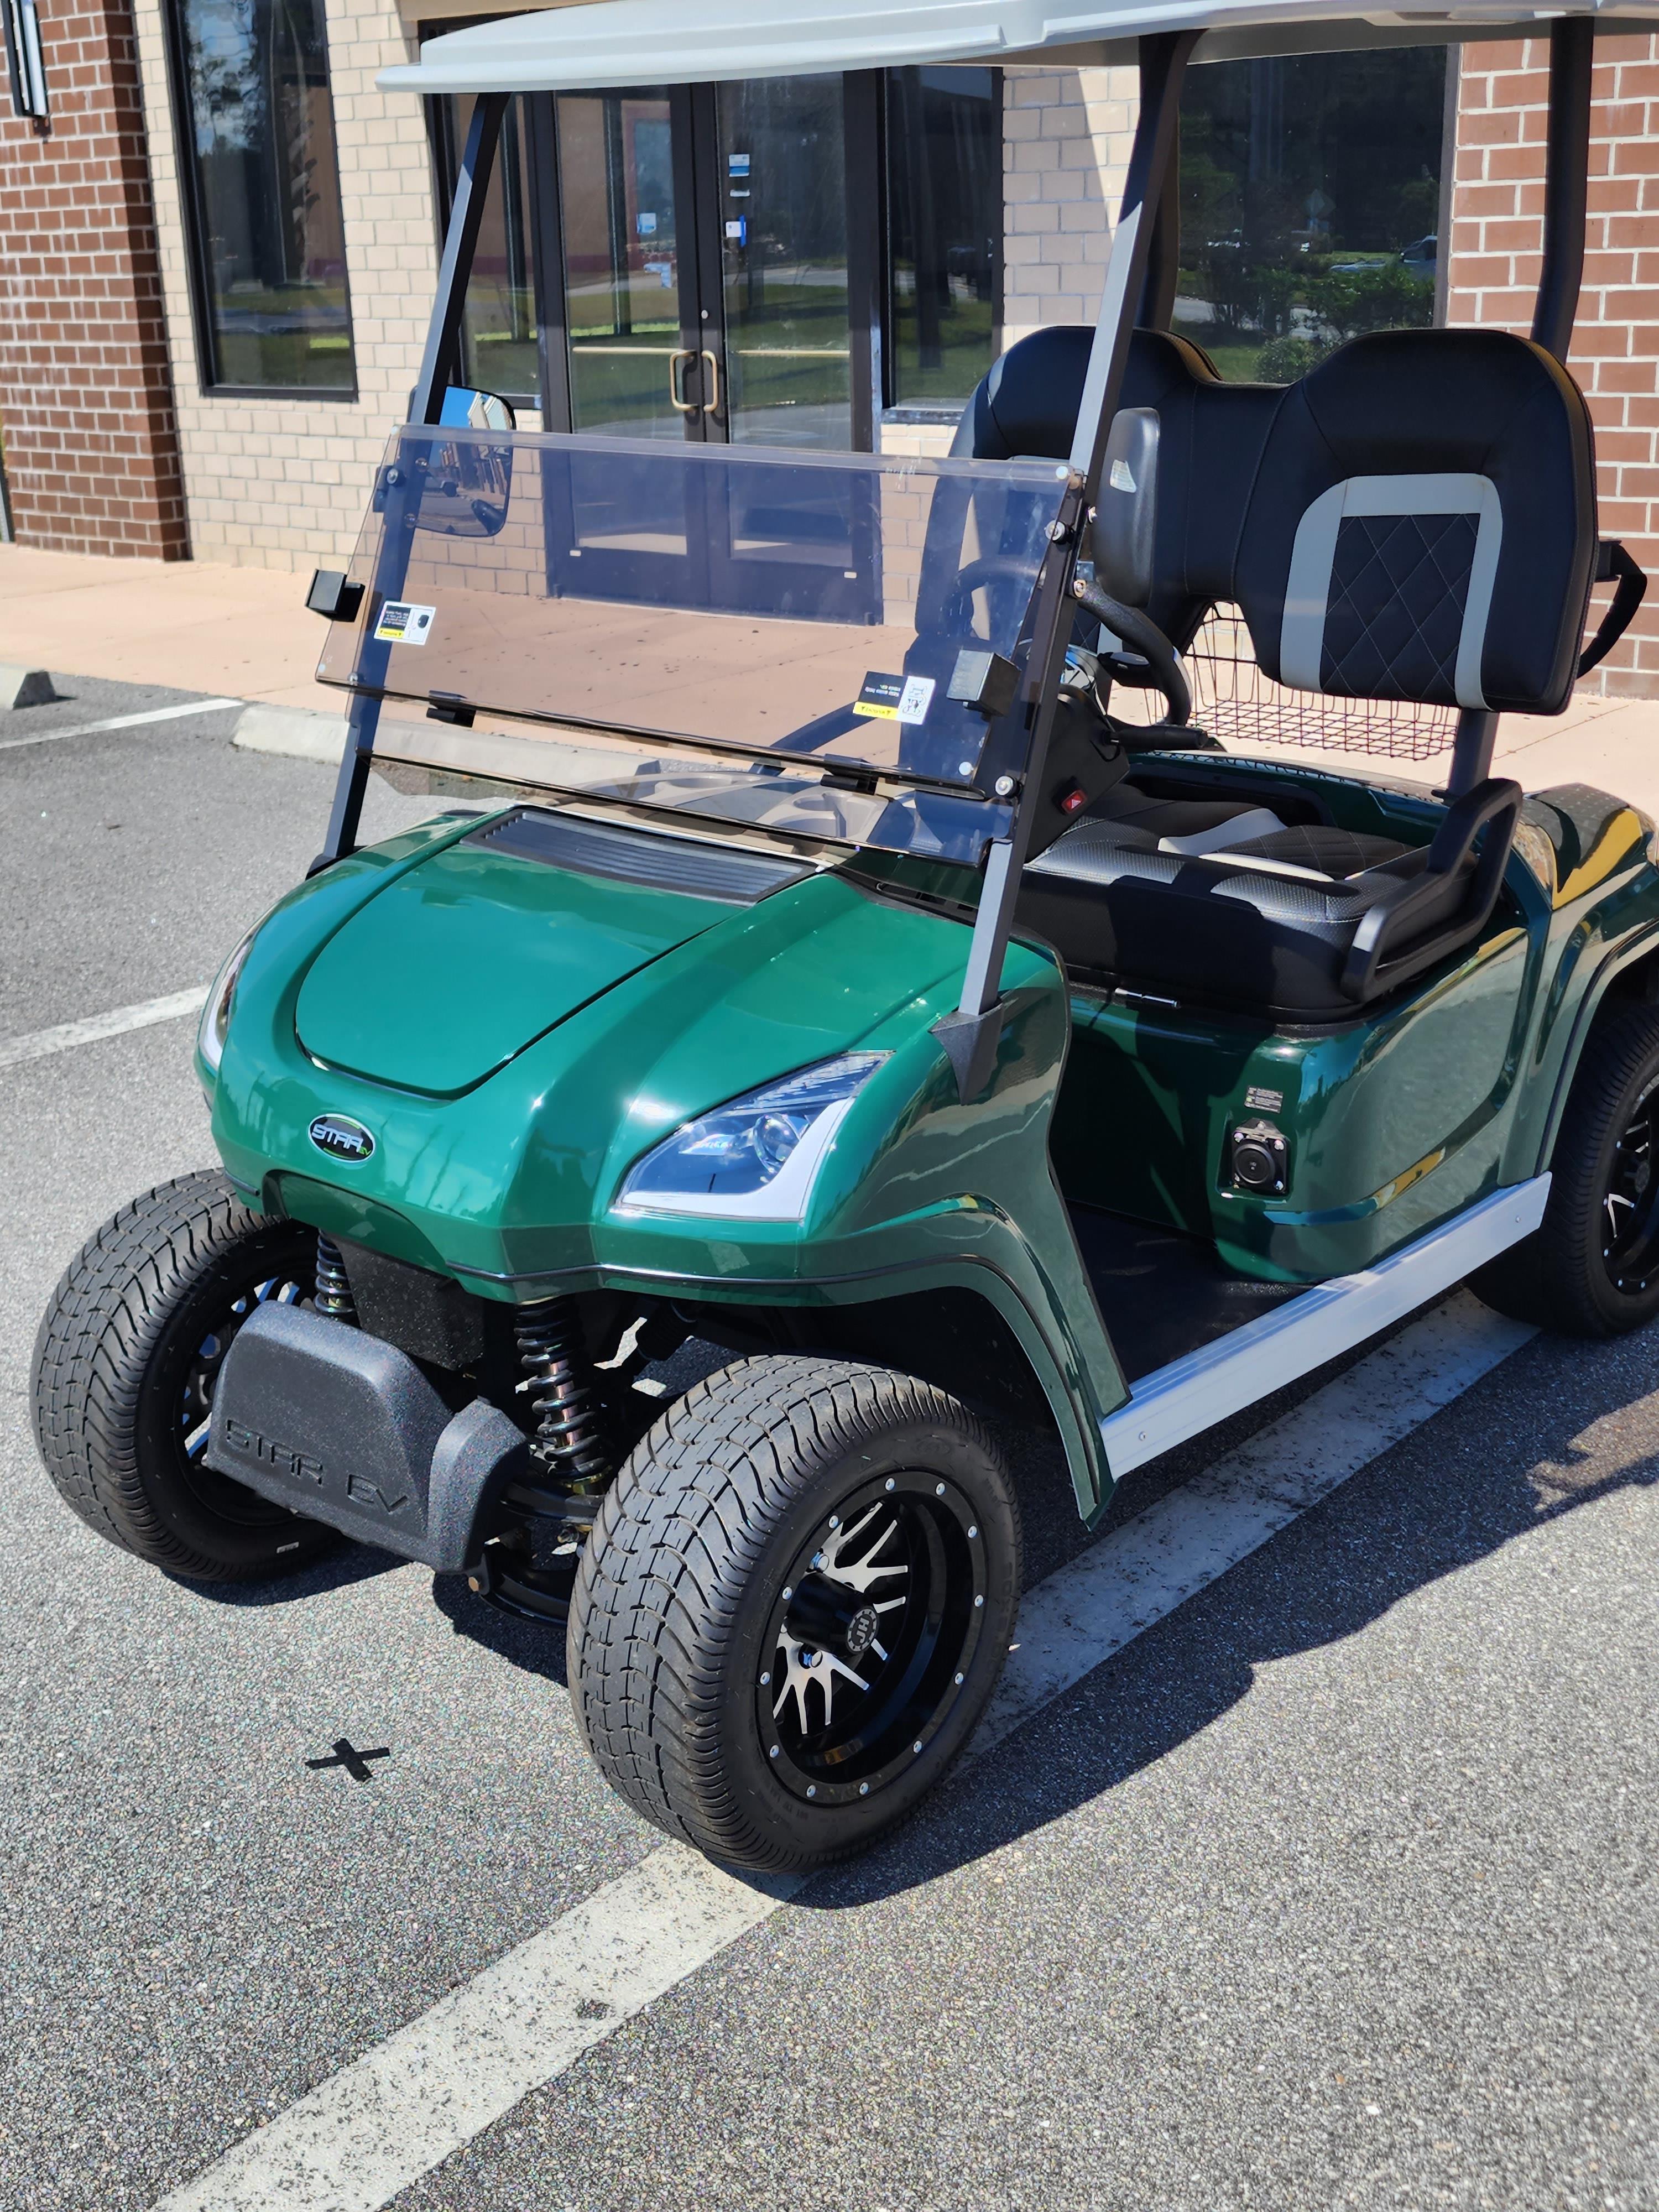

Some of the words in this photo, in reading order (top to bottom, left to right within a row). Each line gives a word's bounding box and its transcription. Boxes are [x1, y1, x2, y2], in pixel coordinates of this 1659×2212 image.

[312, 1124, 363, 1152] STAR
[226, 1419, 323, 1486] STAR
[347, 1474, 408, 1514] EV
